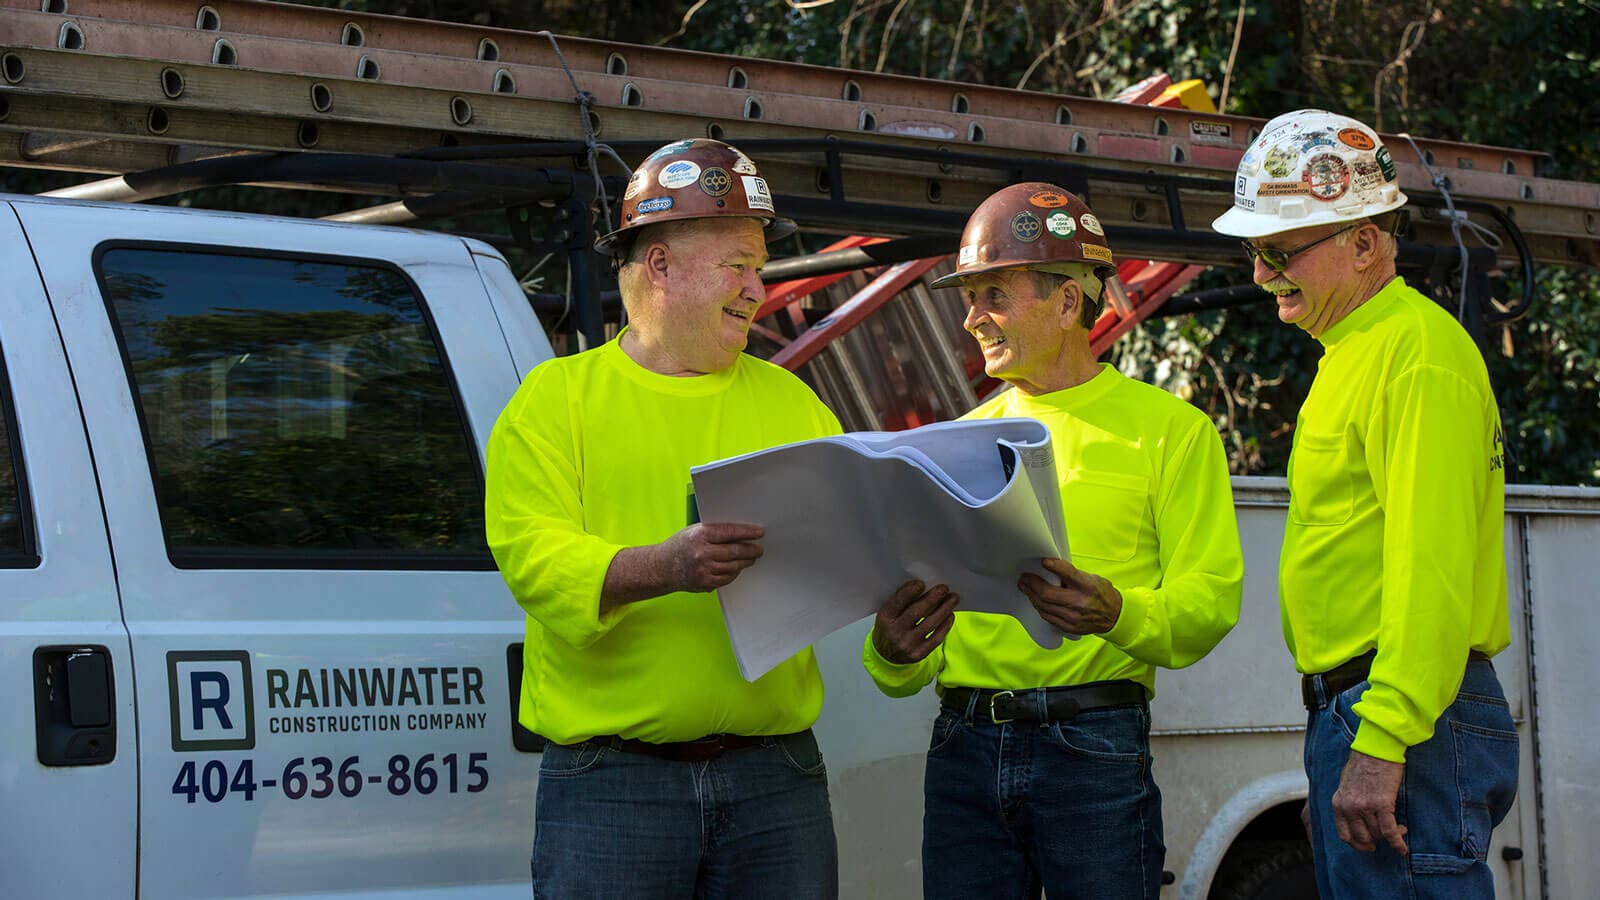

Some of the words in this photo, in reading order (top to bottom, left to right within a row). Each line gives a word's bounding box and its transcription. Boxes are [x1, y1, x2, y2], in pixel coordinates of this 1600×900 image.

[1193, 123, 1228, 134] CAUTION
[190, 671, 233, 730] R
[266, 667, 487, 709] RAINWATER
[269, 714, 400, 734] CONSTRUCTION
[407, 712, 487, 731] COMPANY
[171, 752, 490, 804] 404-636-8615
